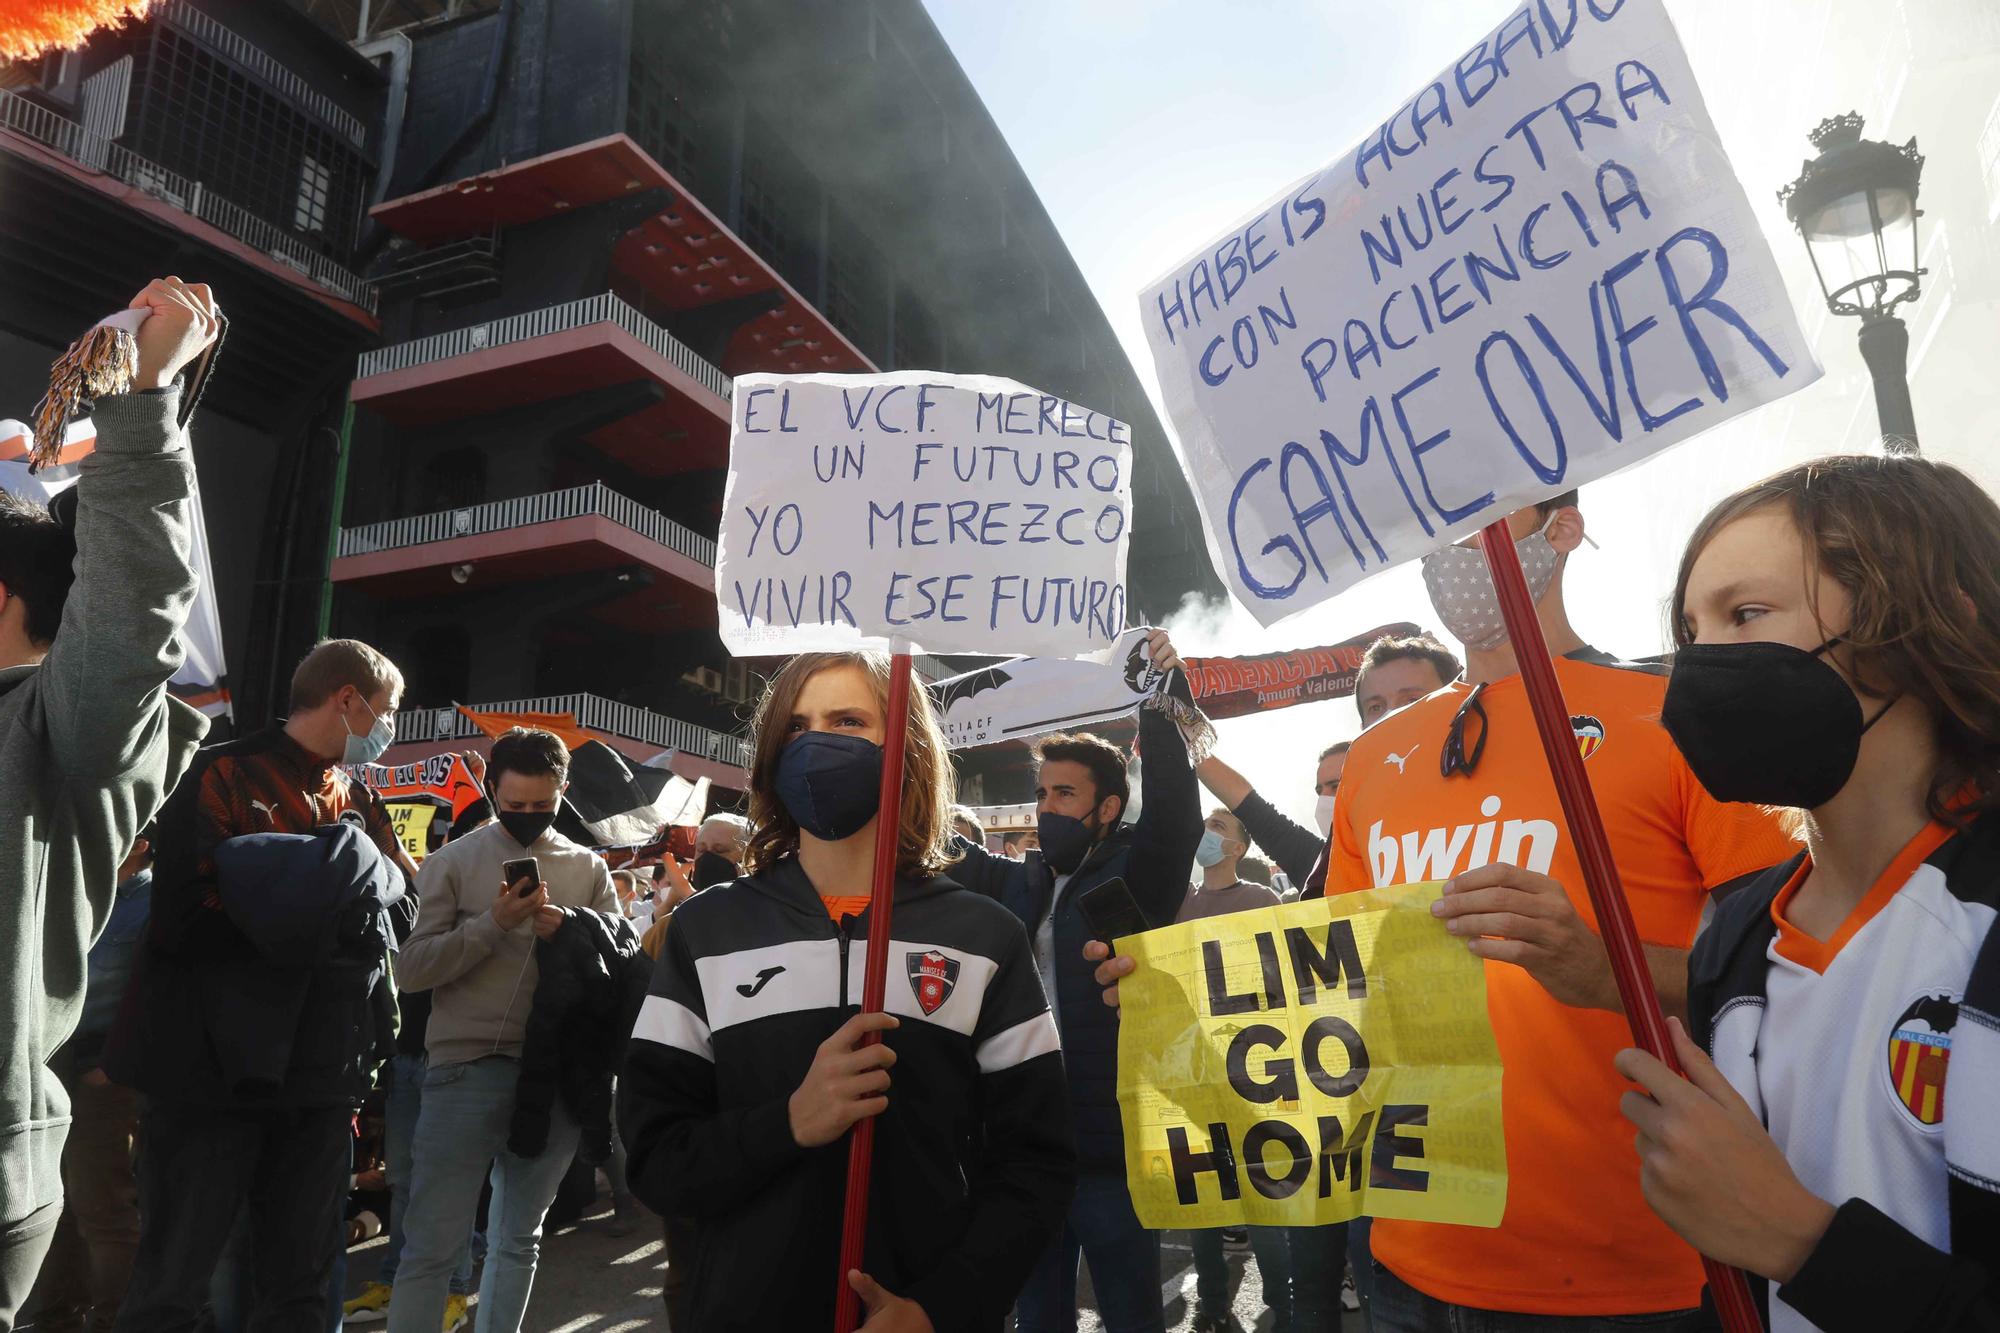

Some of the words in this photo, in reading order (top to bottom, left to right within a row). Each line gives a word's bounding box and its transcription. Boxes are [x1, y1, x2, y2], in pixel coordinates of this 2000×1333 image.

[1157, 181, 1326, 344] HABEIS
[1198, 287, 1297, 387] CON
[1359, 60, 1671, 285] NUESTRA
[1300, 159, 1652, 403] PACIENCIA
[745, 388, 798, 434] EL
[976, 392, 1129, 444] MERECE
[1227, 366, 1496, 600] GAME
[1475, 227, 1790, 486] OVER
[813, 441, 865, 483] UN
[745, 503, 803, 557] YO
[868, 500, 1124, 549] MEREZCO
[735, 570, 857, 629] VIVIR
[885, 571, 974, 626] ESE
[991, 574, 1125, 643] FUTURO
[1183, 652, 1338, 699] VALENCIA
[1257, 687, 1302, 704] Amunt
[1306, 675, 1355, 695] Valenc
[1368, 795, 1558, 889] bwin
[1201, 919, 1368, 1017] LIM
[1226, 1015, 1370, 1104] GO
[1165, 1103, 1429, 1206] HOME
